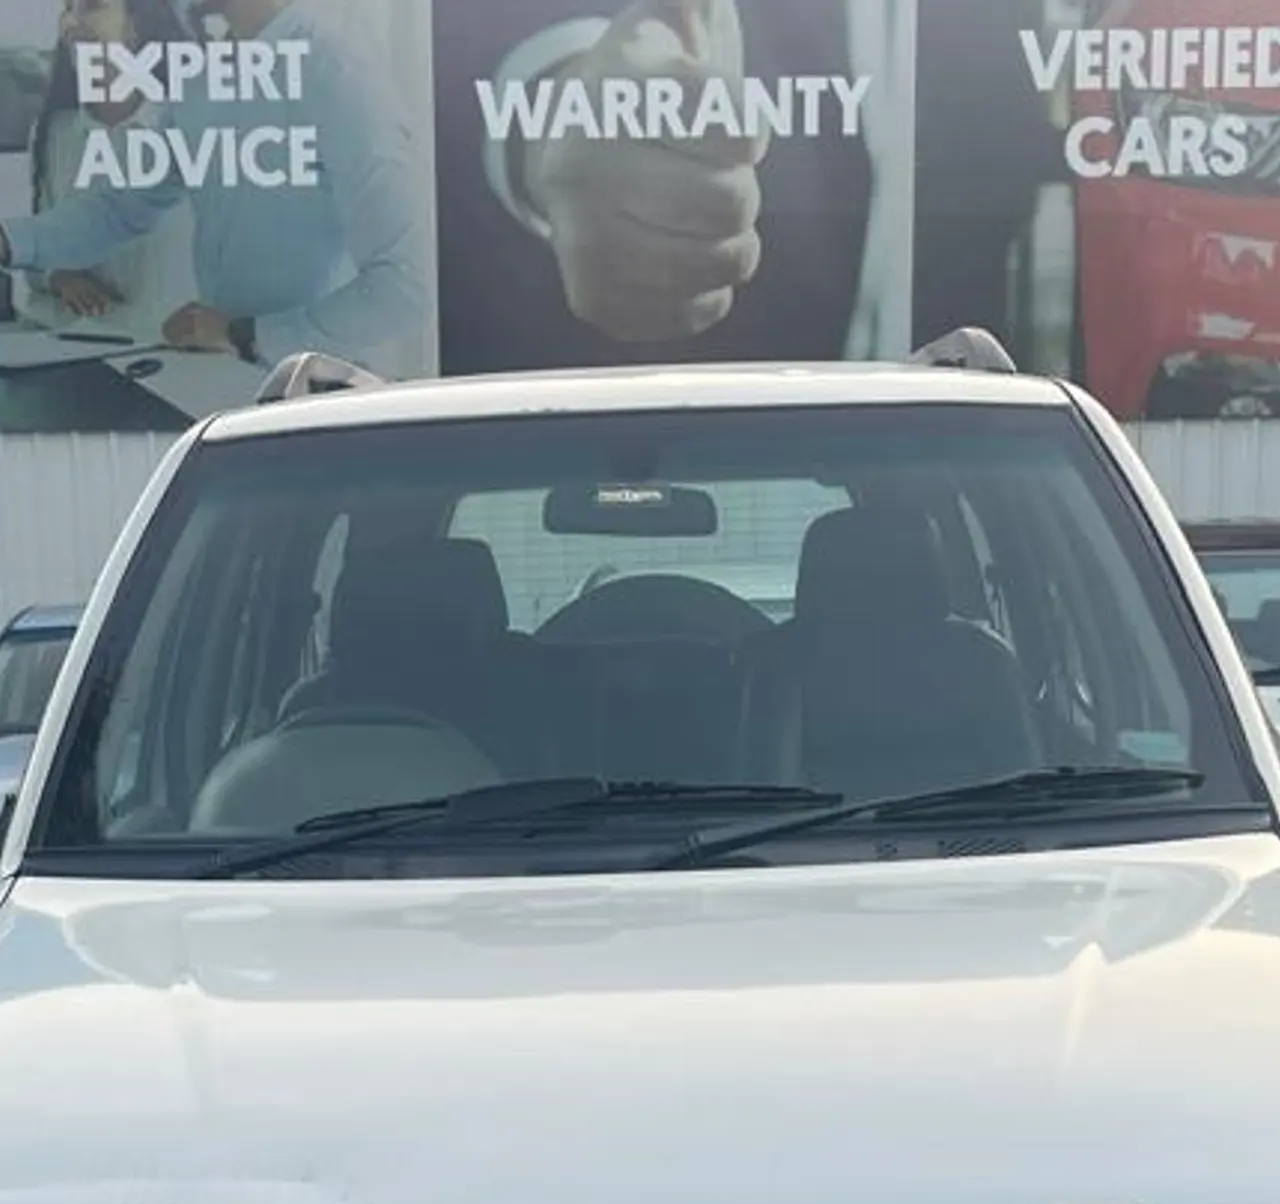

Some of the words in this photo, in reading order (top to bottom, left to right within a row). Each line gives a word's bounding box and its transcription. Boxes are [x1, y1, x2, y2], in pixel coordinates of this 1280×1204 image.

[75, 40, 310, 103] EXPERT
[474, 74, 871, 140] WARRANTY
[73, 125, 318, 190] ADVICE
[1064, 114, 1248, 178] CARS
